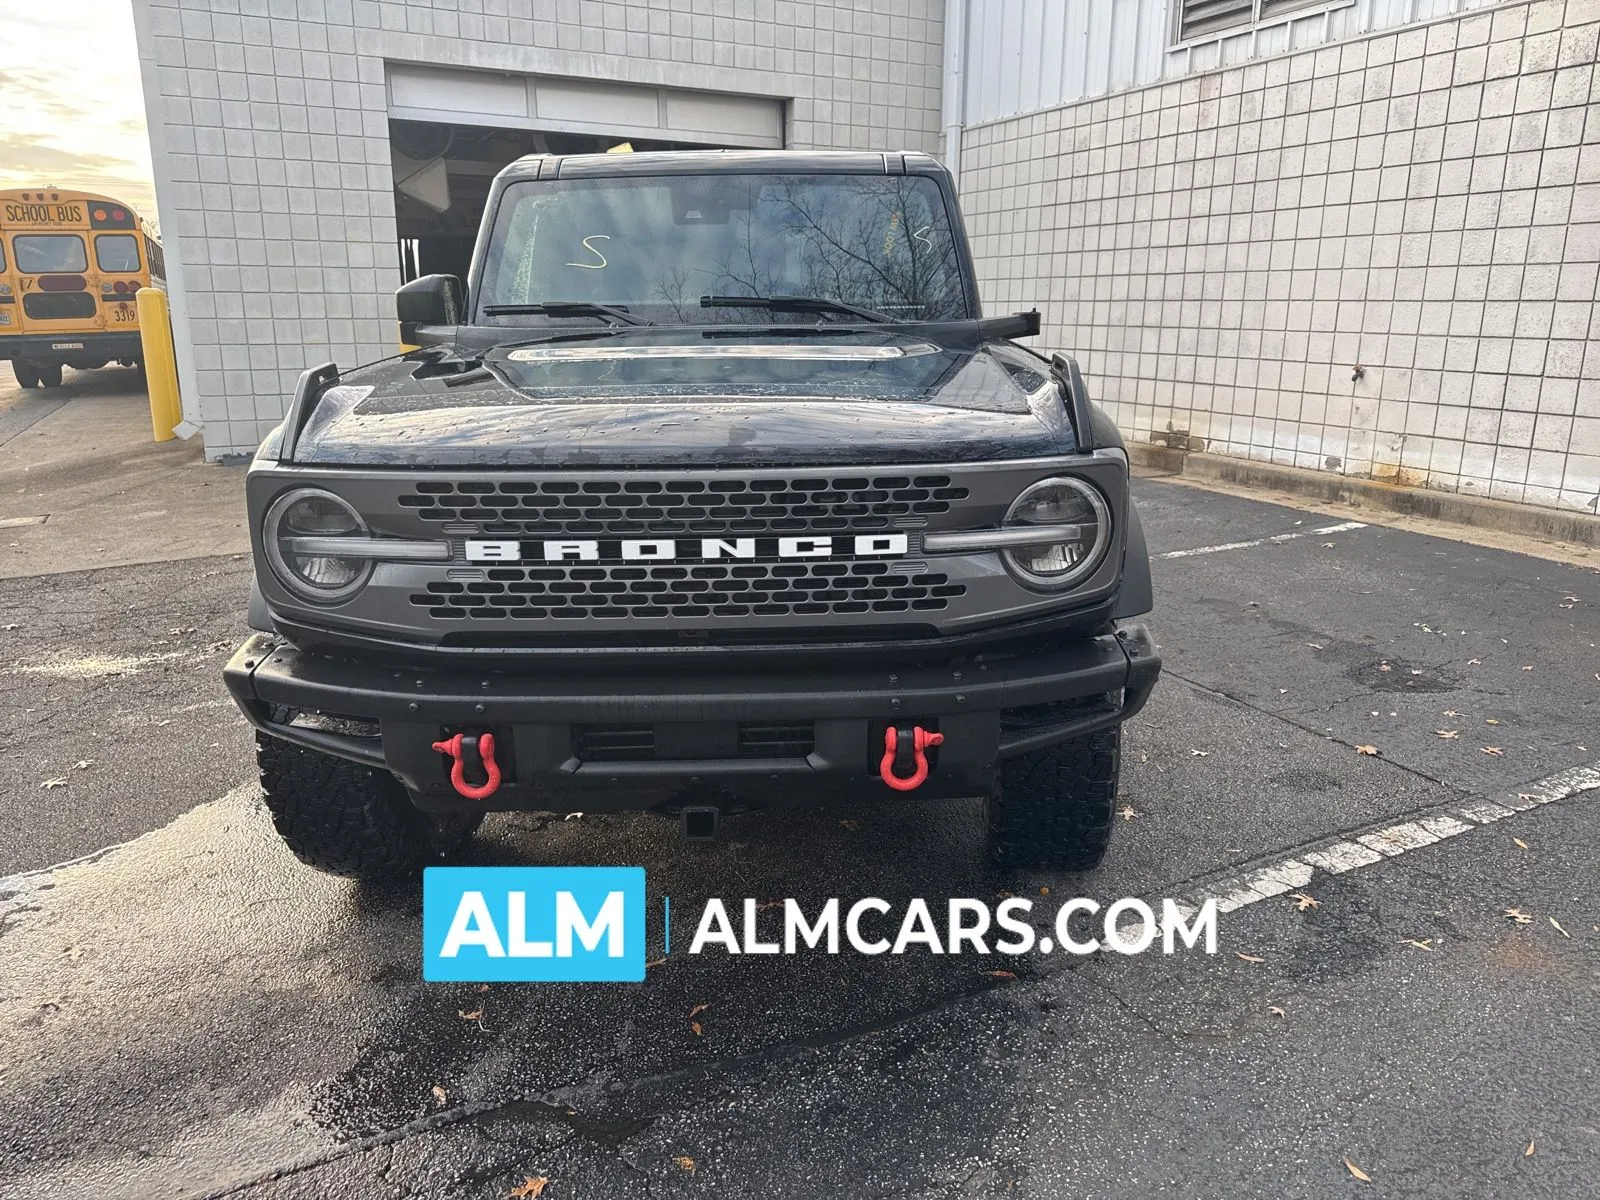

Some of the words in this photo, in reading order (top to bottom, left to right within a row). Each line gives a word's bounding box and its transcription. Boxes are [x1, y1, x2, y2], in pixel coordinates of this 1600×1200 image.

[6, 204, 55, 222] SCHOOL
[57, 205, 82, 222] BUS
[565, 234, 611, 269] S
[115, 310, 135, 322] 3319
[465, 533, 909, 561] BRONCO
